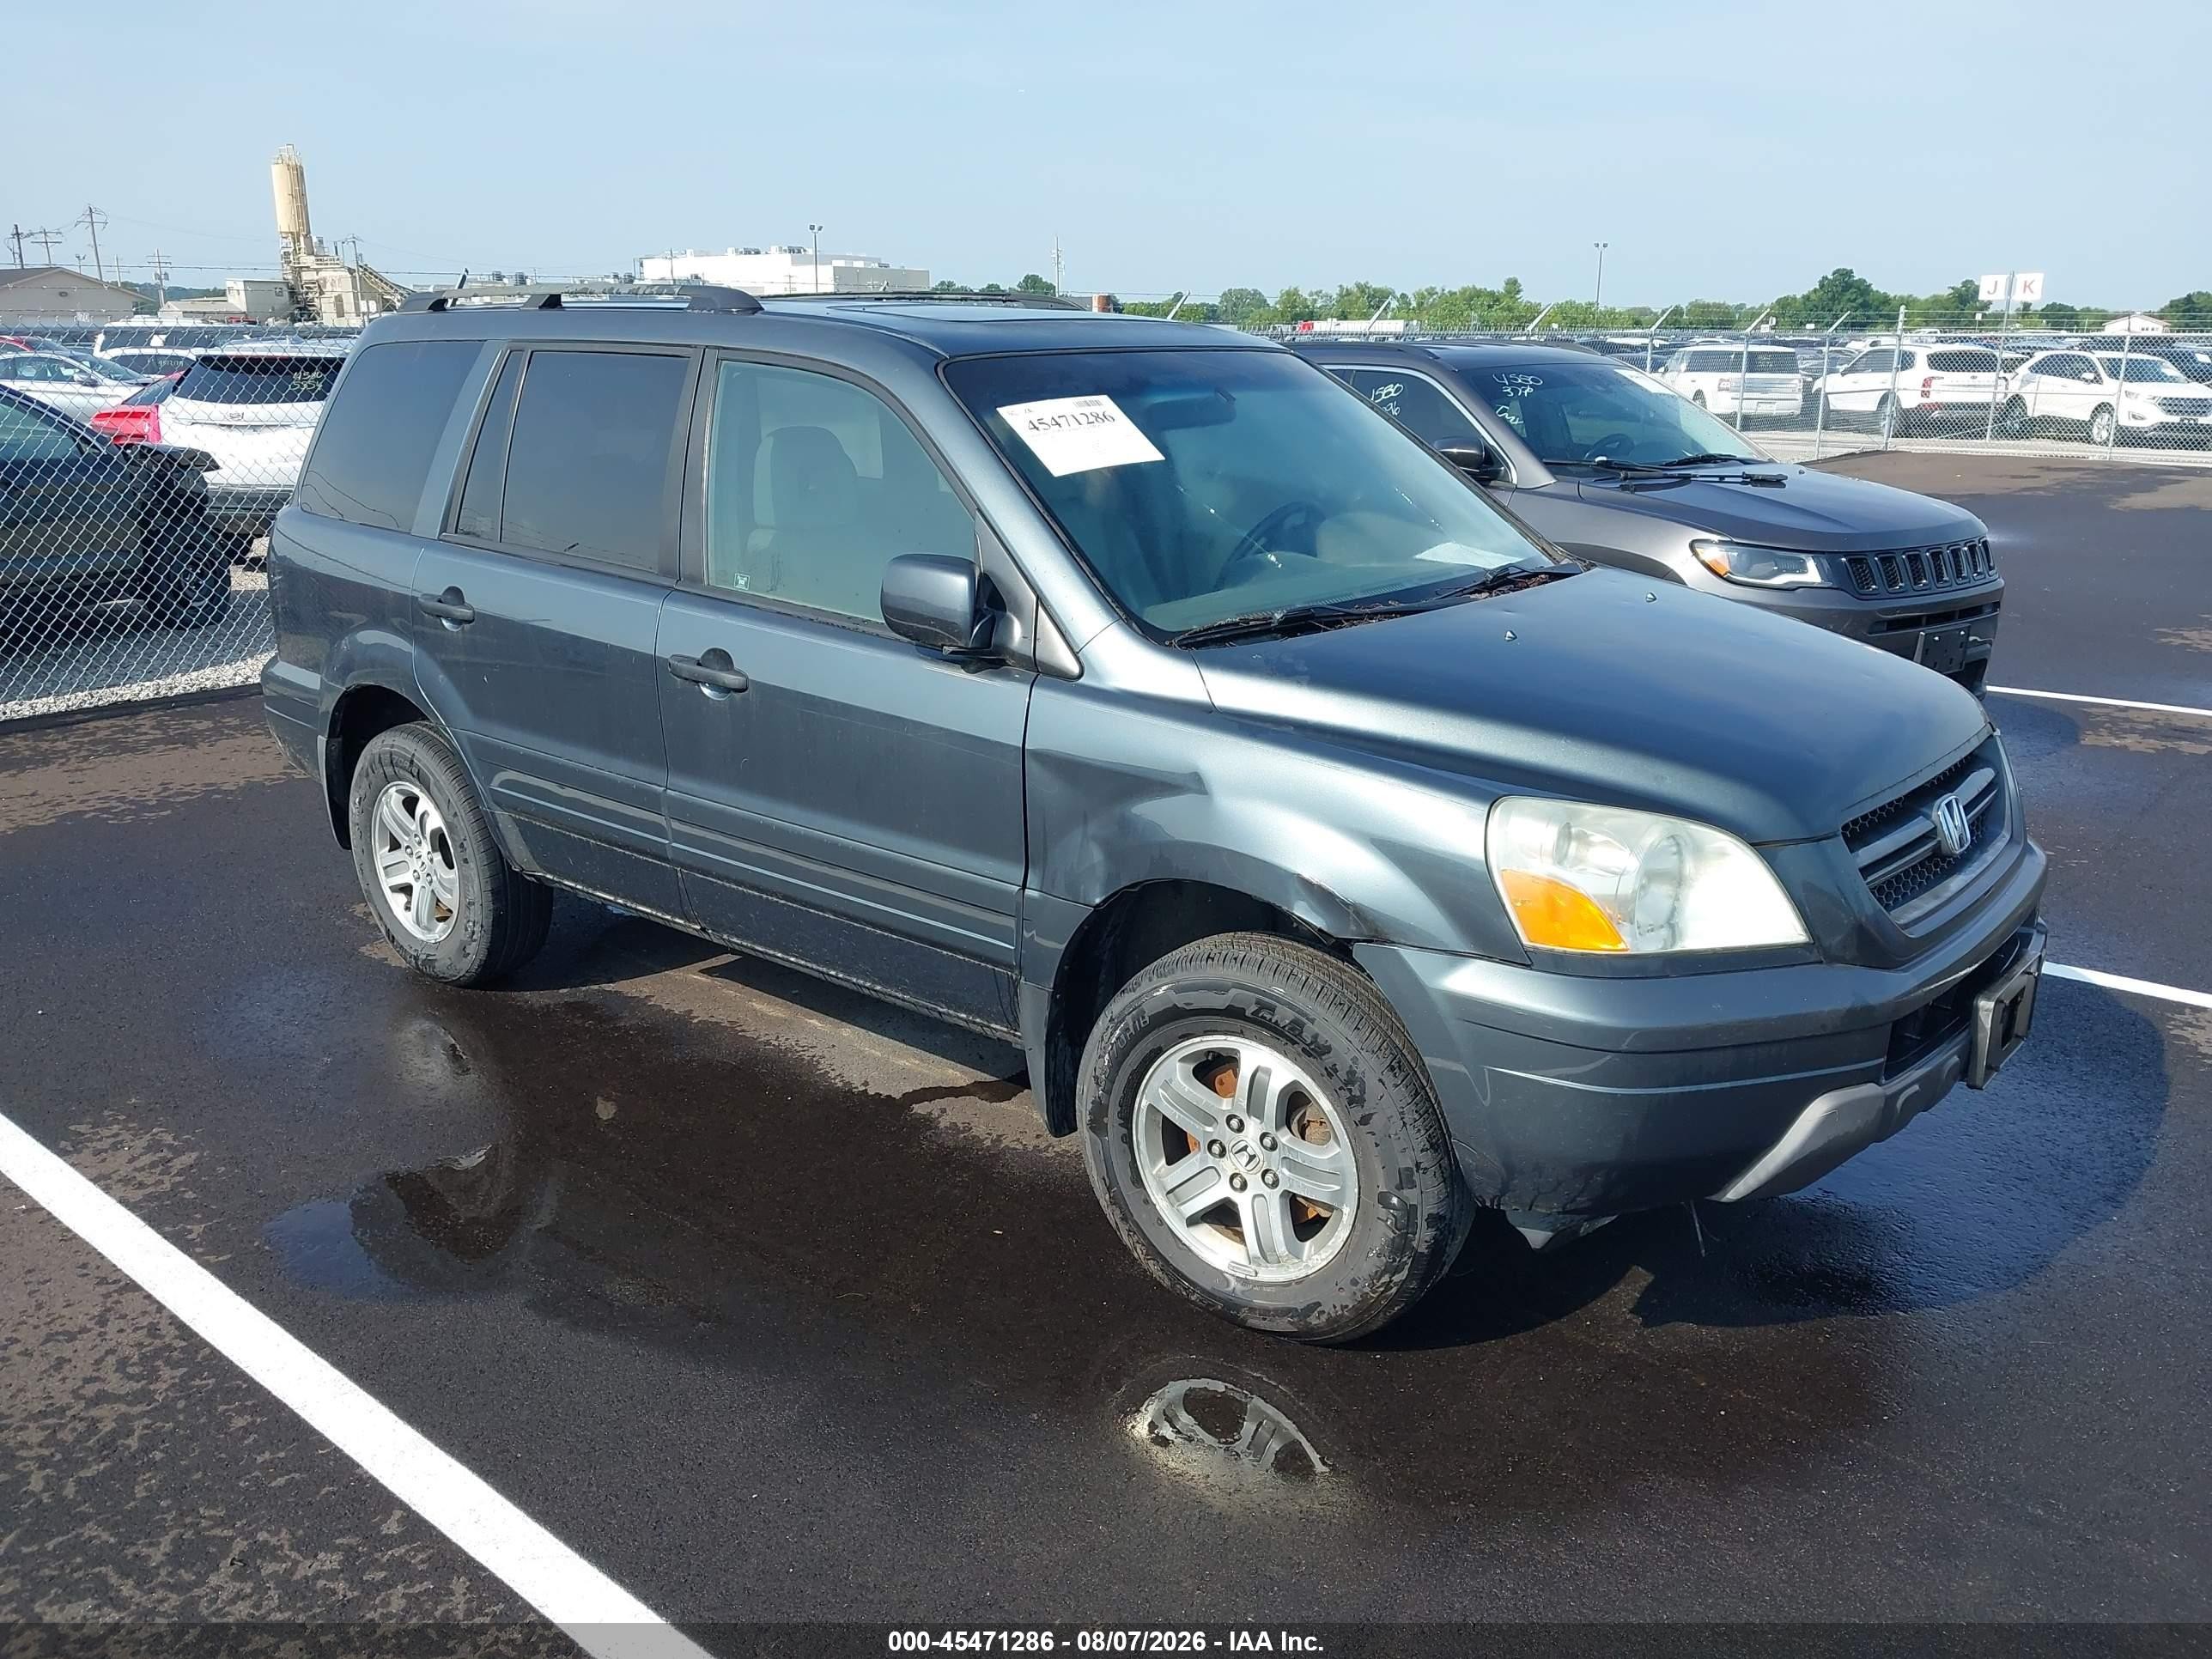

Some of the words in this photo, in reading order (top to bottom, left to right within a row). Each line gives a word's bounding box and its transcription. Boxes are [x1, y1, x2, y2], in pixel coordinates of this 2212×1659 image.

[1987, 280, 1998, 295] J
[2023, 279, 2036, 294] K
[1028, 410, 1115, 432] 45471286
